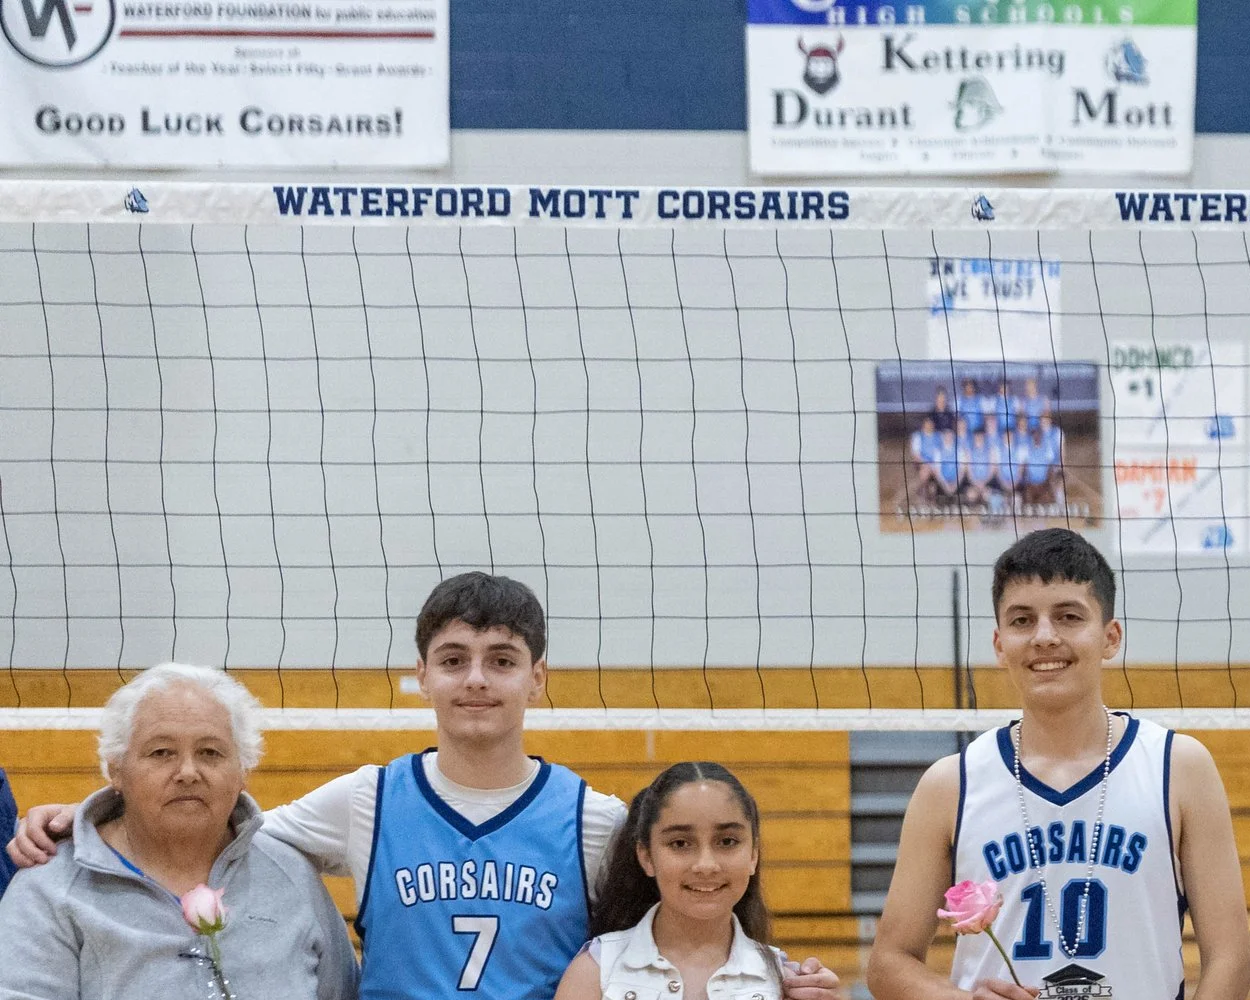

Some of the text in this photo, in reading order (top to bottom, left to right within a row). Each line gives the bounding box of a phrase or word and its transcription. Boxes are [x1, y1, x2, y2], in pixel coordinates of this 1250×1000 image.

[123, 3, 212, 17] WATERFORD
[217, 3, 312, 18] FOUNDATION
[827, 5, 926, 24] HIGH
[955, 5, 1133, 24] SCHOOLS
[881, 33, 1065, 77] Kettering
[771, 89, 913, 128] Durant
[1071, 87, 1173, 127] Mott
[273, 186, 849, 220] WATERFORD MOTT CORSAIRS
[982, 819, 1148, 882] CORSAIRS
[395, 859, 559, 911] CORSAIRS
[1012, 878, 1108, 961] 10
[451, 914, 500, 992] 7
[1055, 985, 1092, 994] Class of
